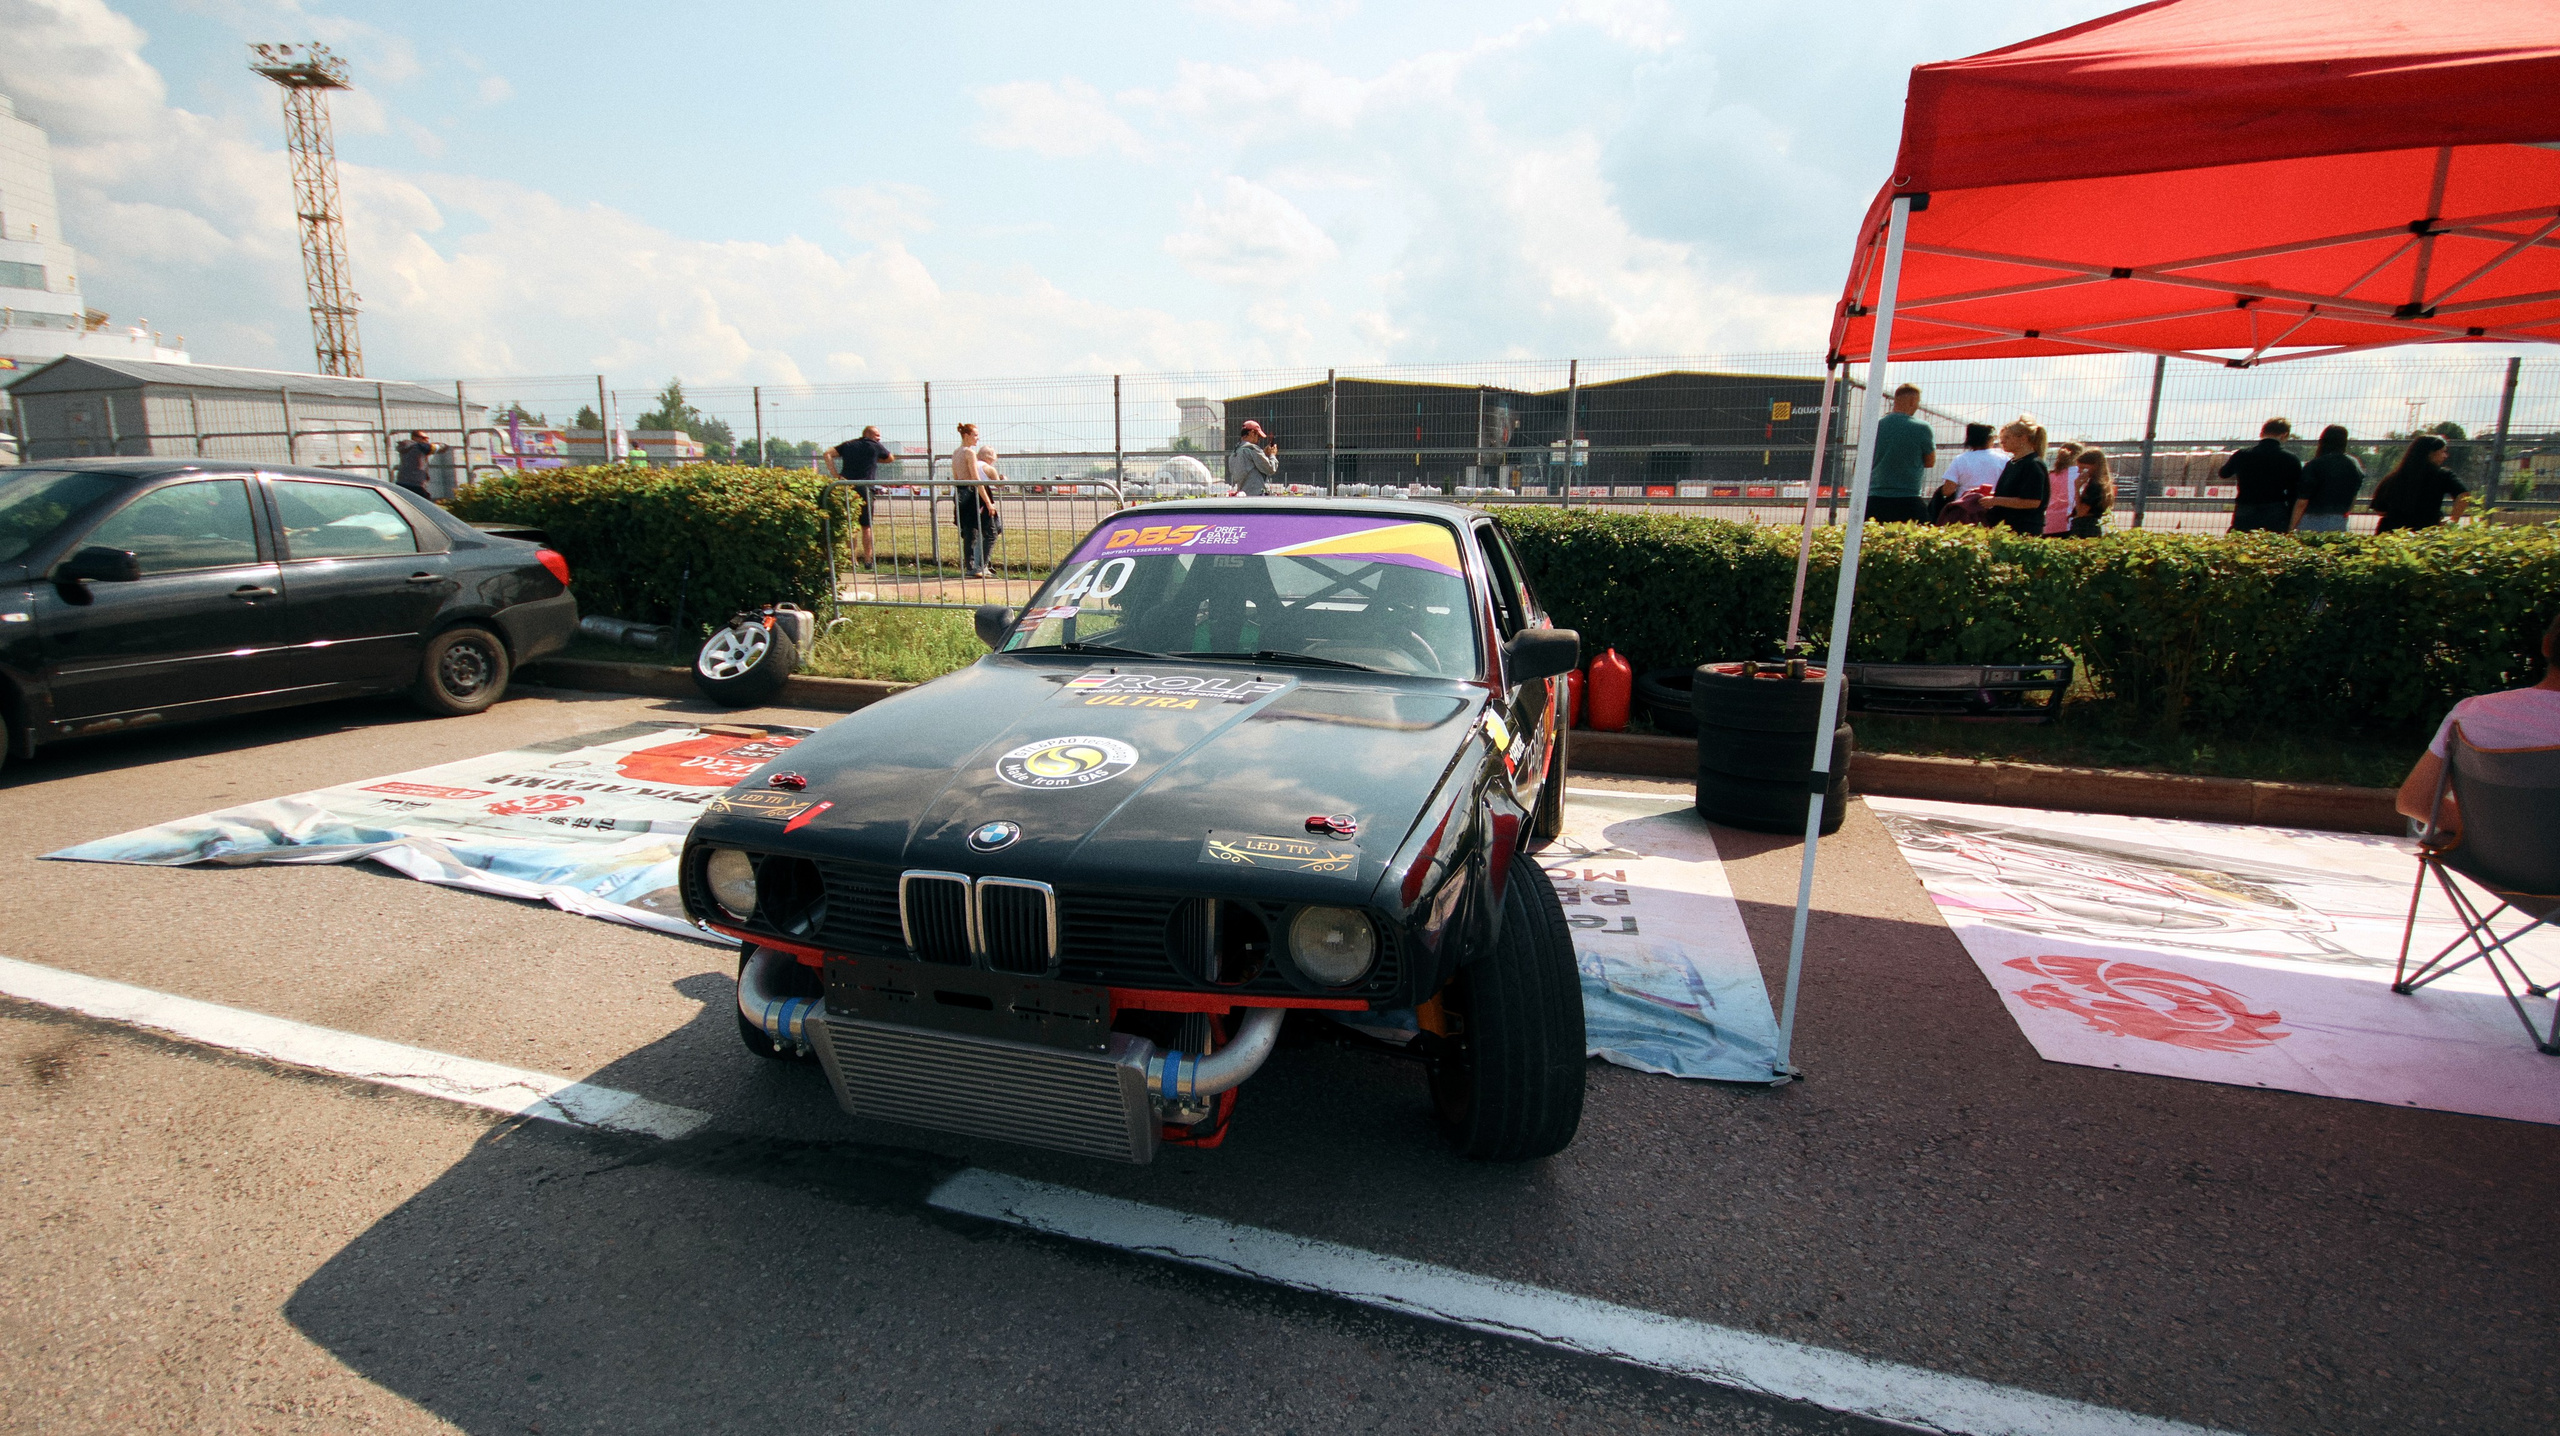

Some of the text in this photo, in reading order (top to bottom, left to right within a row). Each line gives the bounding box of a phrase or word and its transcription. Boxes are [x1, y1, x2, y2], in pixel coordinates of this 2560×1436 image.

[1791, 405, 1840, 415] AQUAPST
[1105, 524, 1208, 549] DBS
[1198, 537, 1239, 545] SERIES
[1206, 531, 1248, 539] BATTLE
[1101, 546, 1173, 556] DRIFTBATTLESERIES.RU
[1053, 557, 1136, 600] 40
[1100, 674, 1286, 696] ROLF
[1085, 695, 1200, 710] ULTRA
[1005, 763, 1109, 786] Made from GAS
[738, 794, 788, 804] LED TIV
[1246, 840, 1316, 855] LED TIV
